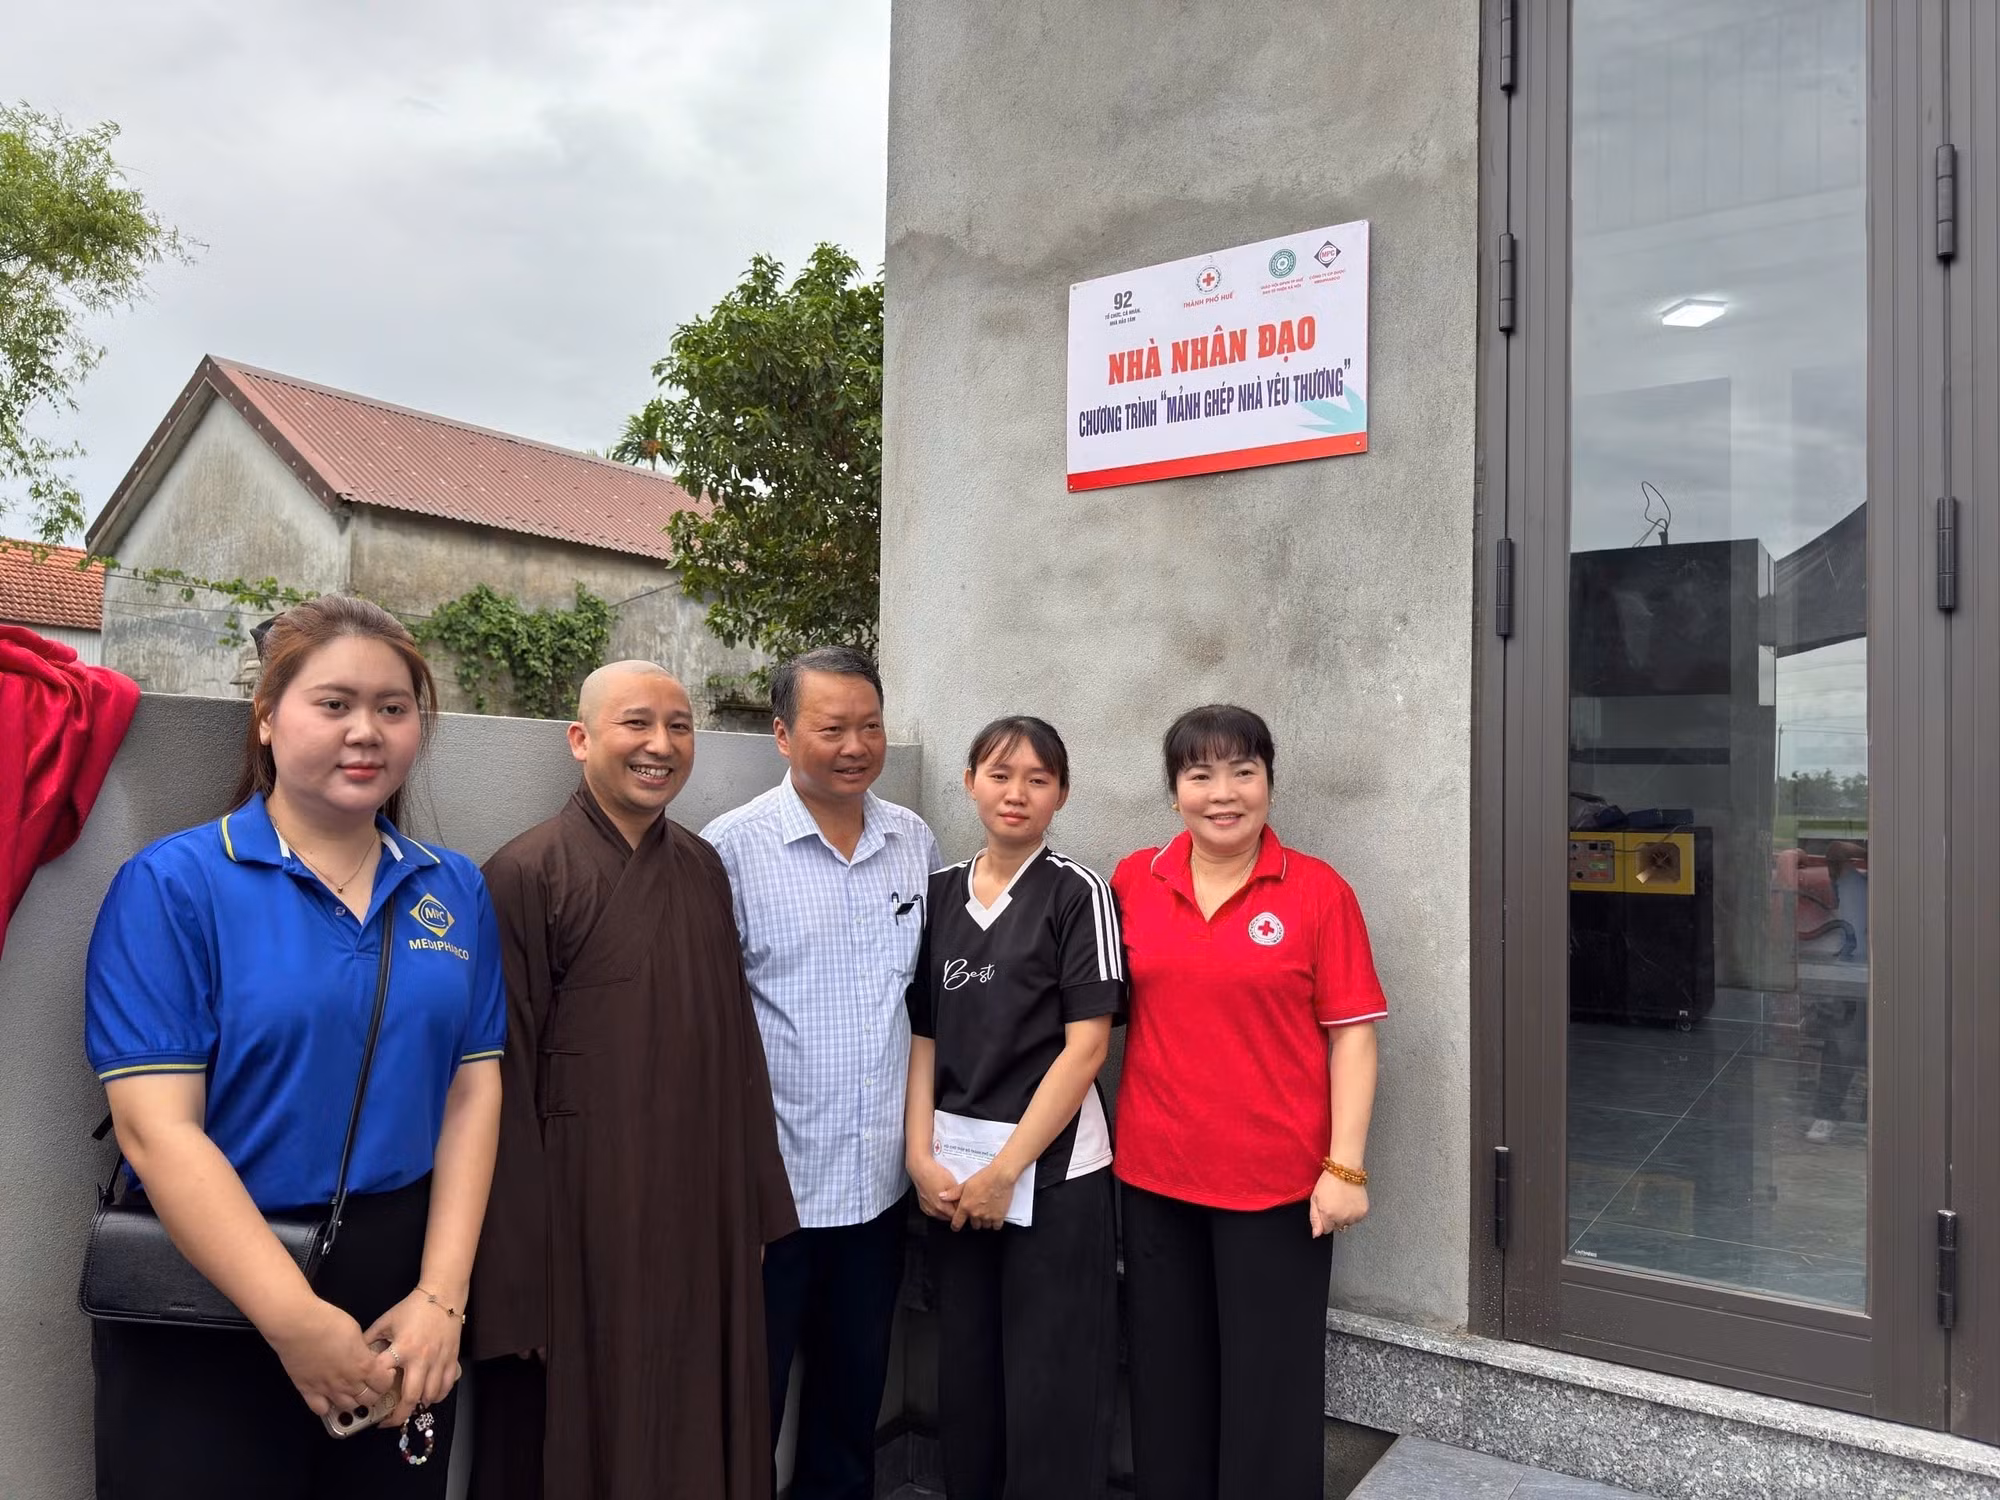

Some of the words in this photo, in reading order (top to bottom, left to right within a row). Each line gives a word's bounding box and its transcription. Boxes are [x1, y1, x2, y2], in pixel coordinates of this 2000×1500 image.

[1321, 250, 1335, 258] MPC
[1114, 291, 1133, 310] 92
[1183, 299, 1204, 308] THÀNH
[1205, 293, 1220, 304] PHỐ
[1221, 290, 1234, 301] HUẾ
[1108, 338, 1162, 385] NHÀ
[1171, 325, 1247, 374] NHÂN
[1258, 315, 1316, 363] ĐẠO
[1079, 404, 1122, 437] CHƯƠNG
[1125, 396, 1157, 430] TRÌNH
[1204, 381, 1235, 418] GHÉP
[1238, 375, 1263, 413] NHÀ
[1267, 371, 1290, 407] YÊU
[943, 958, 995, 990] Best
